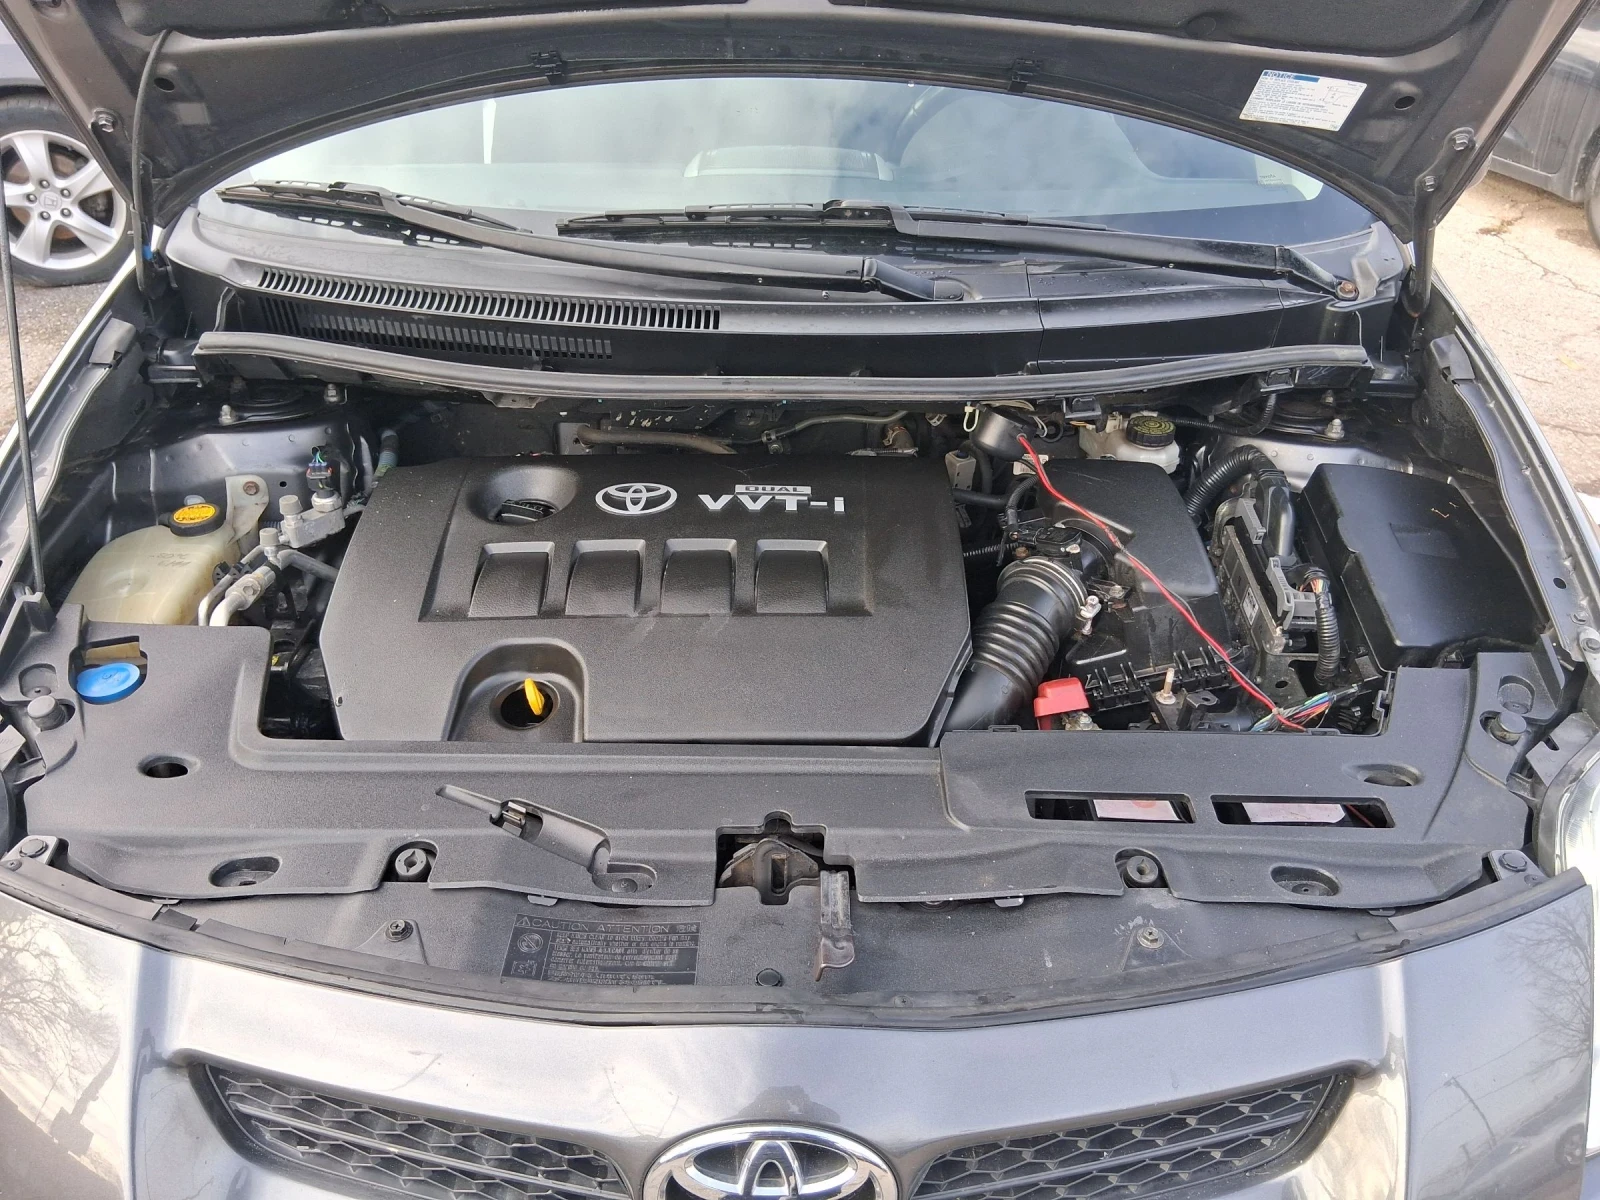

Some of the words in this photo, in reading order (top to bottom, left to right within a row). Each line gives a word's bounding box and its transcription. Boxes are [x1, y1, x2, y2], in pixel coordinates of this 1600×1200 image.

[1267, 71, 1296, 80] NOTICE
[697, 494, 846, 513] VVT-i
[532, 918, 589, 931] CAUTION
[596, 923, 670, 933] ATTENTION
